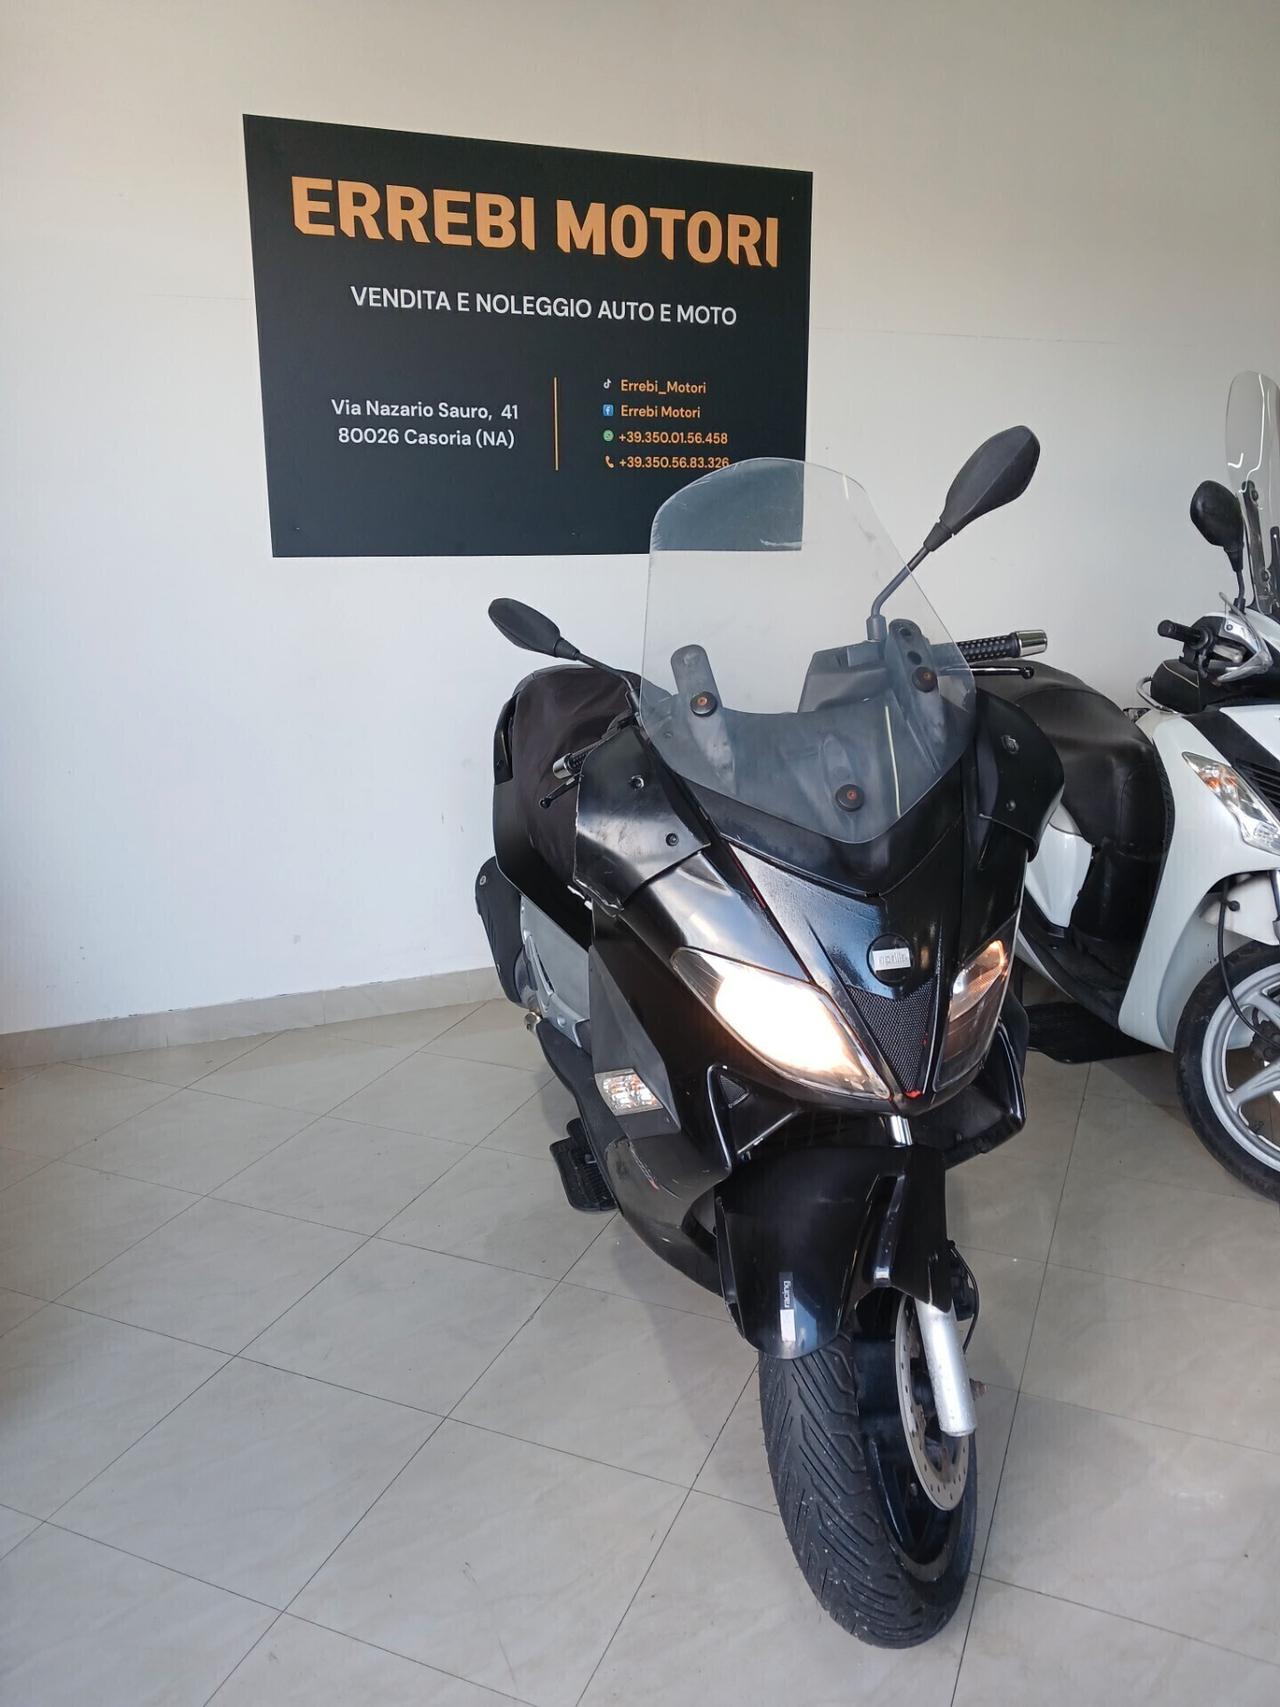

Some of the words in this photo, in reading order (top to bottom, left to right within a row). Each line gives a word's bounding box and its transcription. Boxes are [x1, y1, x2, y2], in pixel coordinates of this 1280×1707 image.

[291, 176, 536, 251] ERREBI
[556, 199, 779, 268] MOTORI
[350, 286, 451, 311] VENDITA
[457, 292, 470, 312] E
[476, 293, 592, 318] NOLEGGIO
[598, 300, 655, 322] AUTO
[661, 304, 672, 323] E
[677, 305, 737, 326] MOTO
[620, 378, 707, 395] Errebi_Motori
[331, 398, 361, 416] Via
[366, 400, 434, 417] Nazario
[438, 402, 493, 421] Sauro,
[501, 404, 519, 420] 41
[620, 404, 658, 418] Errebi
[660, 405, 701, 419] Motori
[338, 427, 399, 446] 80026
[404, 428, 472, 448] Casoria
[476, 429, 515, 450] (NA)
[619, 431, 728, 445] +39.350.01.56.458
[619, 455, 730, 469] +39.350.56.83.326
